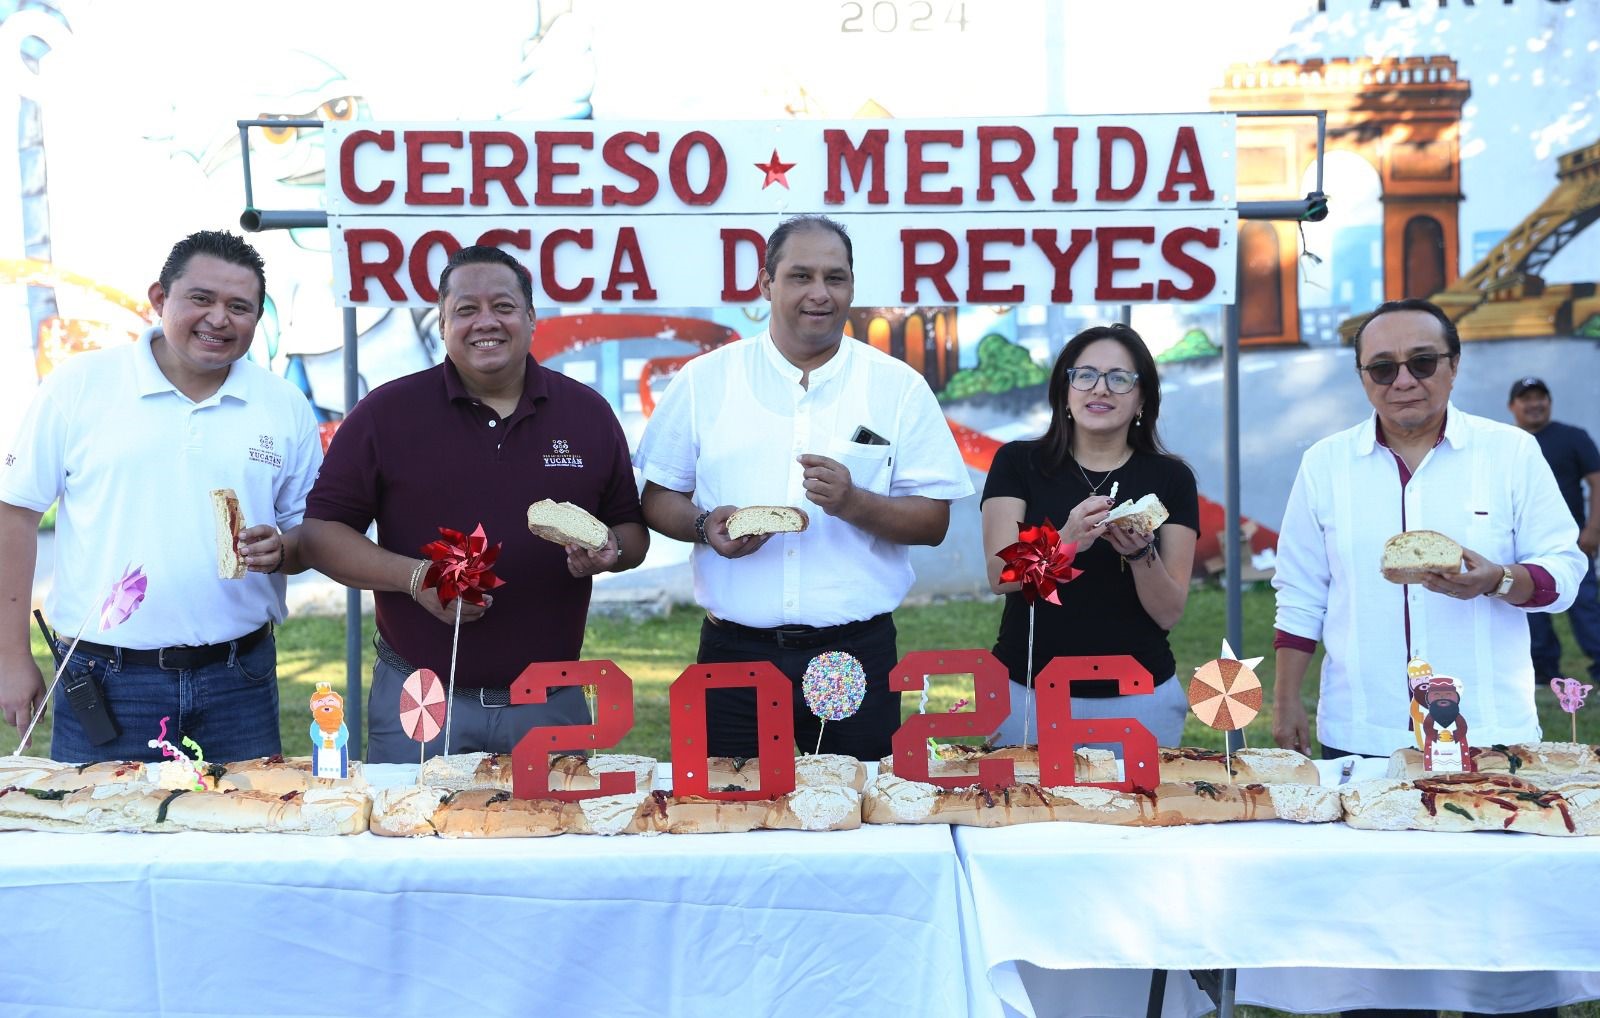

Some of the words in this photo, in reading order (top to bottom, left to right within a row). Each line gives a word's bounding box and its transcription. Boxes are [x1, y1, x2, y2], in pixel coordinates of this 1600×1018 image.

[841, 1, 969, 32] 2024
[340, 130, 728, 206] CERESO
[824, 126, 1214, 204] MERIDA
[900, 227, 1220, 302] REYES
[510, 649, 1160, 800] 2026
